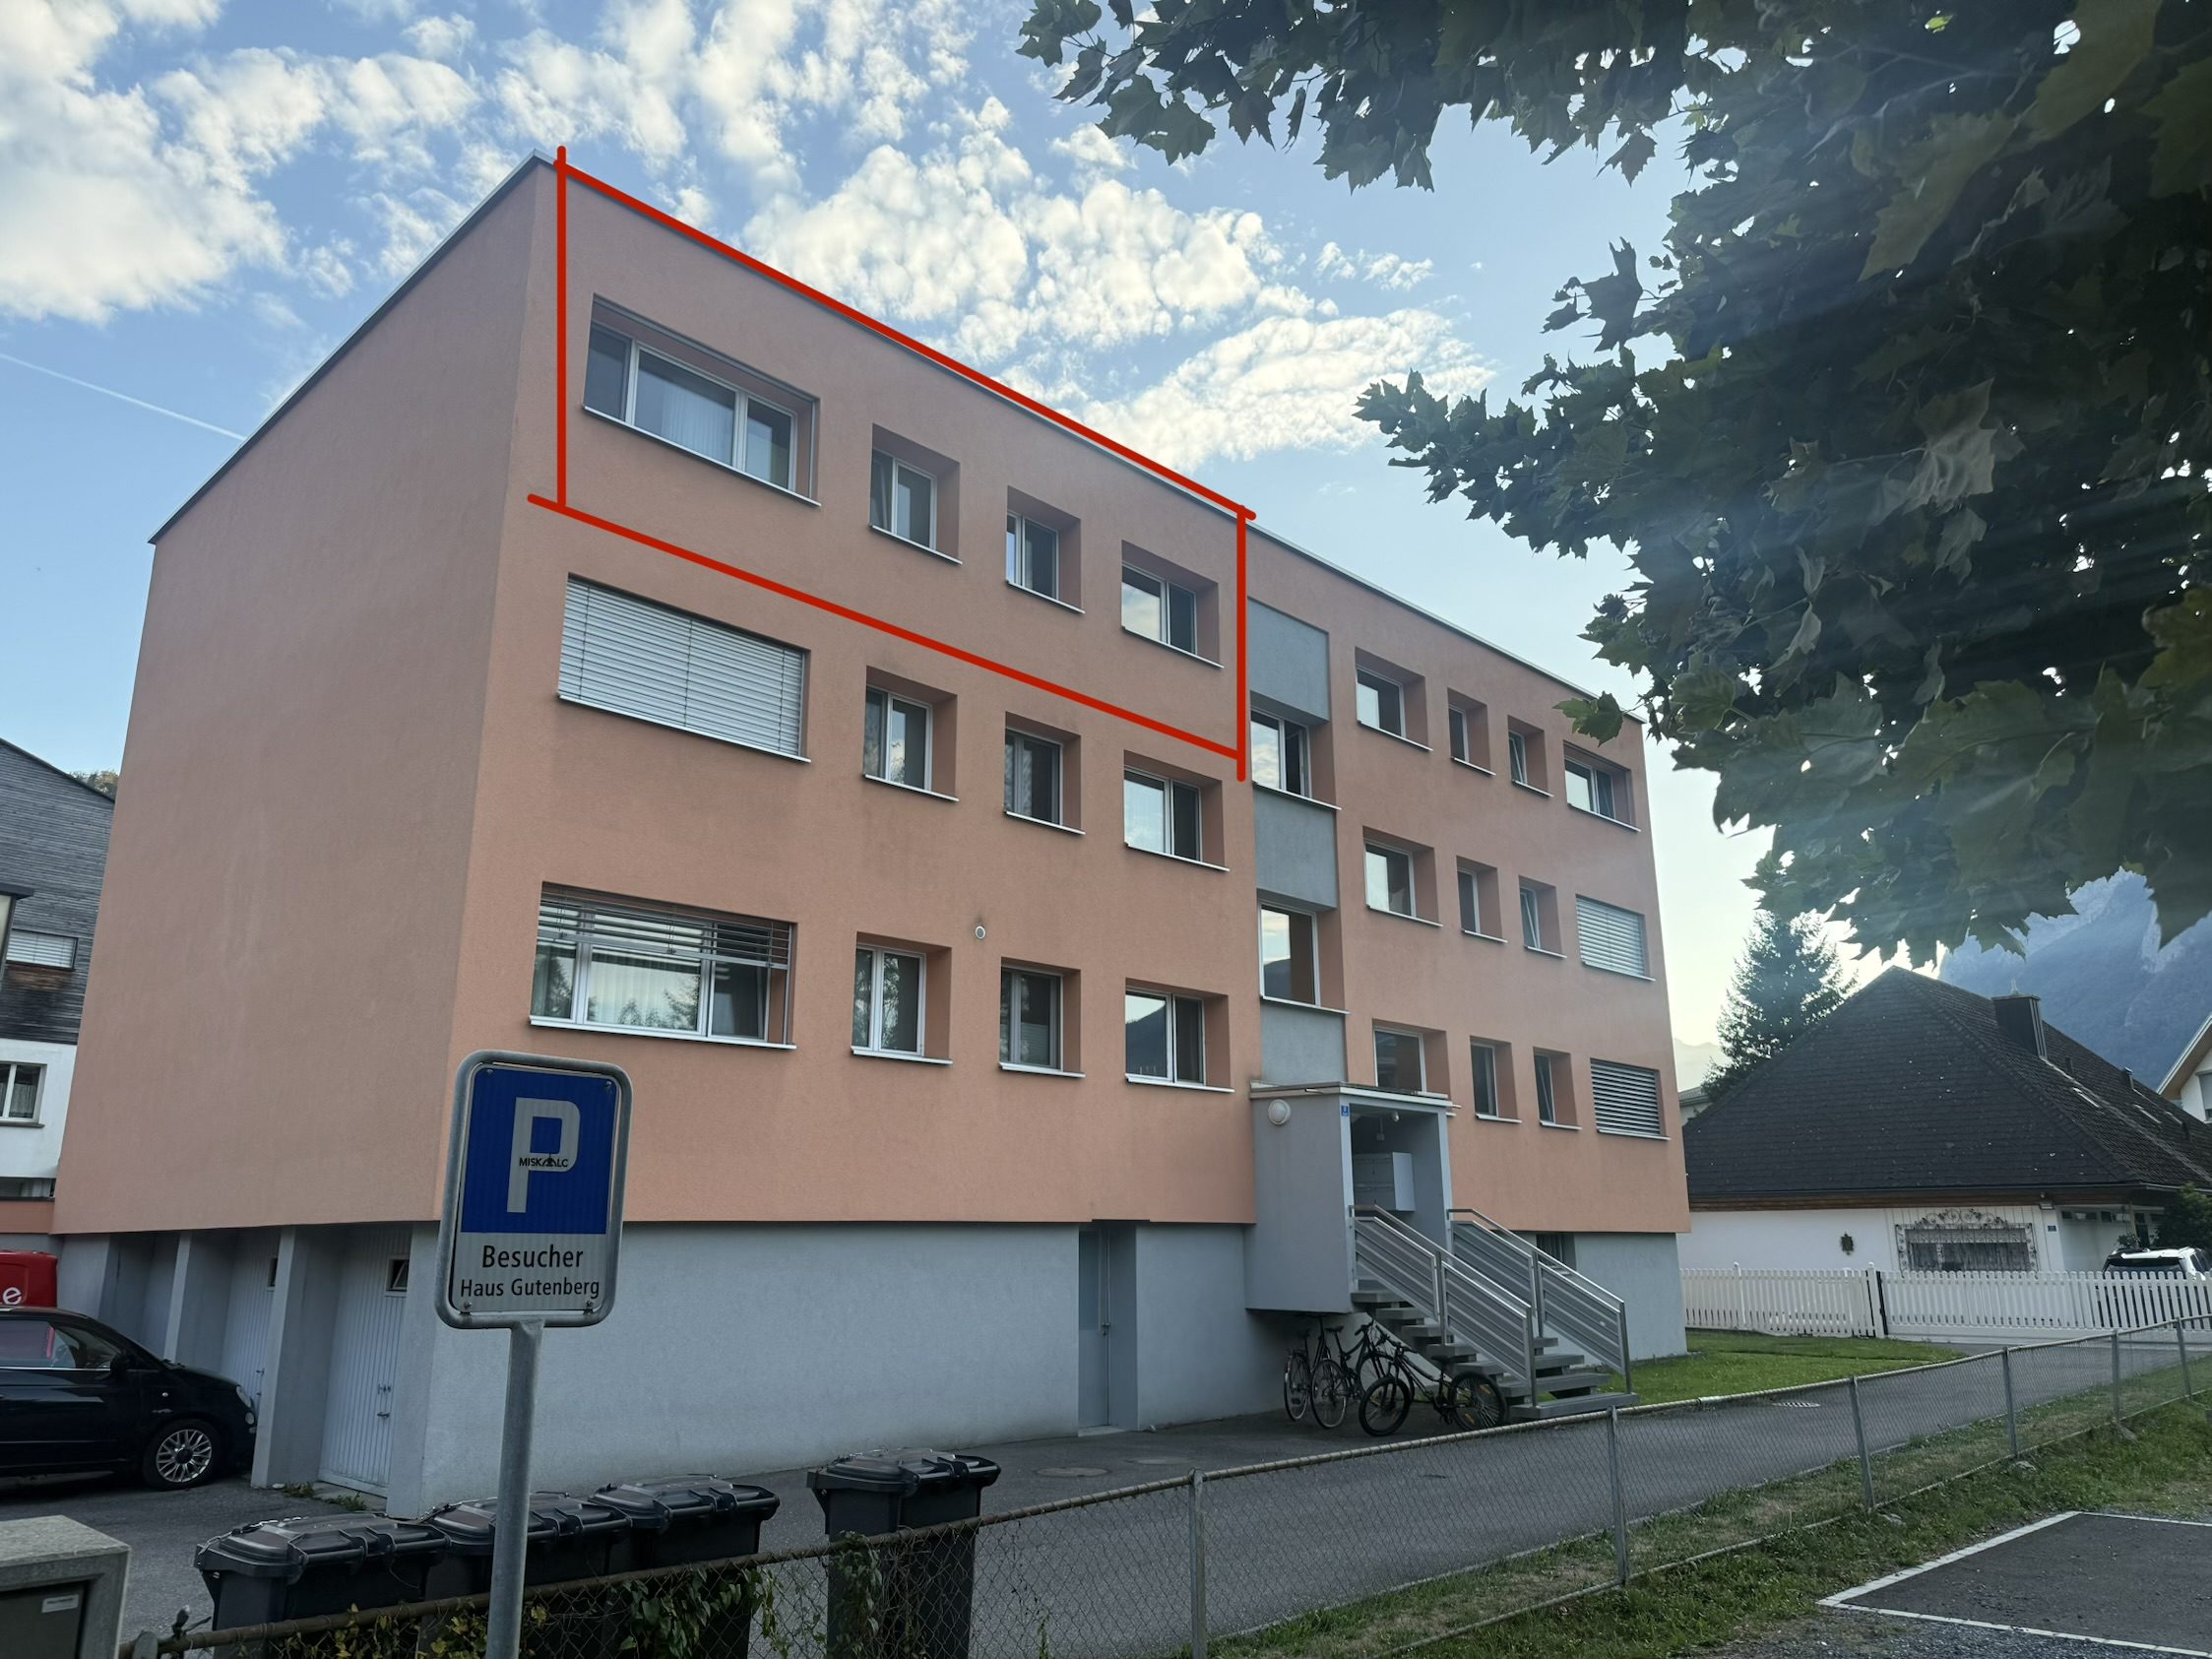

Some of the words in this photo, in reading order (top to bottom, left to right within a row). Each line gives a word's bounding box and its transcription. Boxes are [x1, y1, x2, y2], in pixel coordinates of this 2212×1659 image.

[507, 1097, 581, 1213] P
[482, 1244, 584, 1268] Besucher
[461, 1279, 504, 1298] Haus
[511, 1277, 600, 1300] Gutenberg
